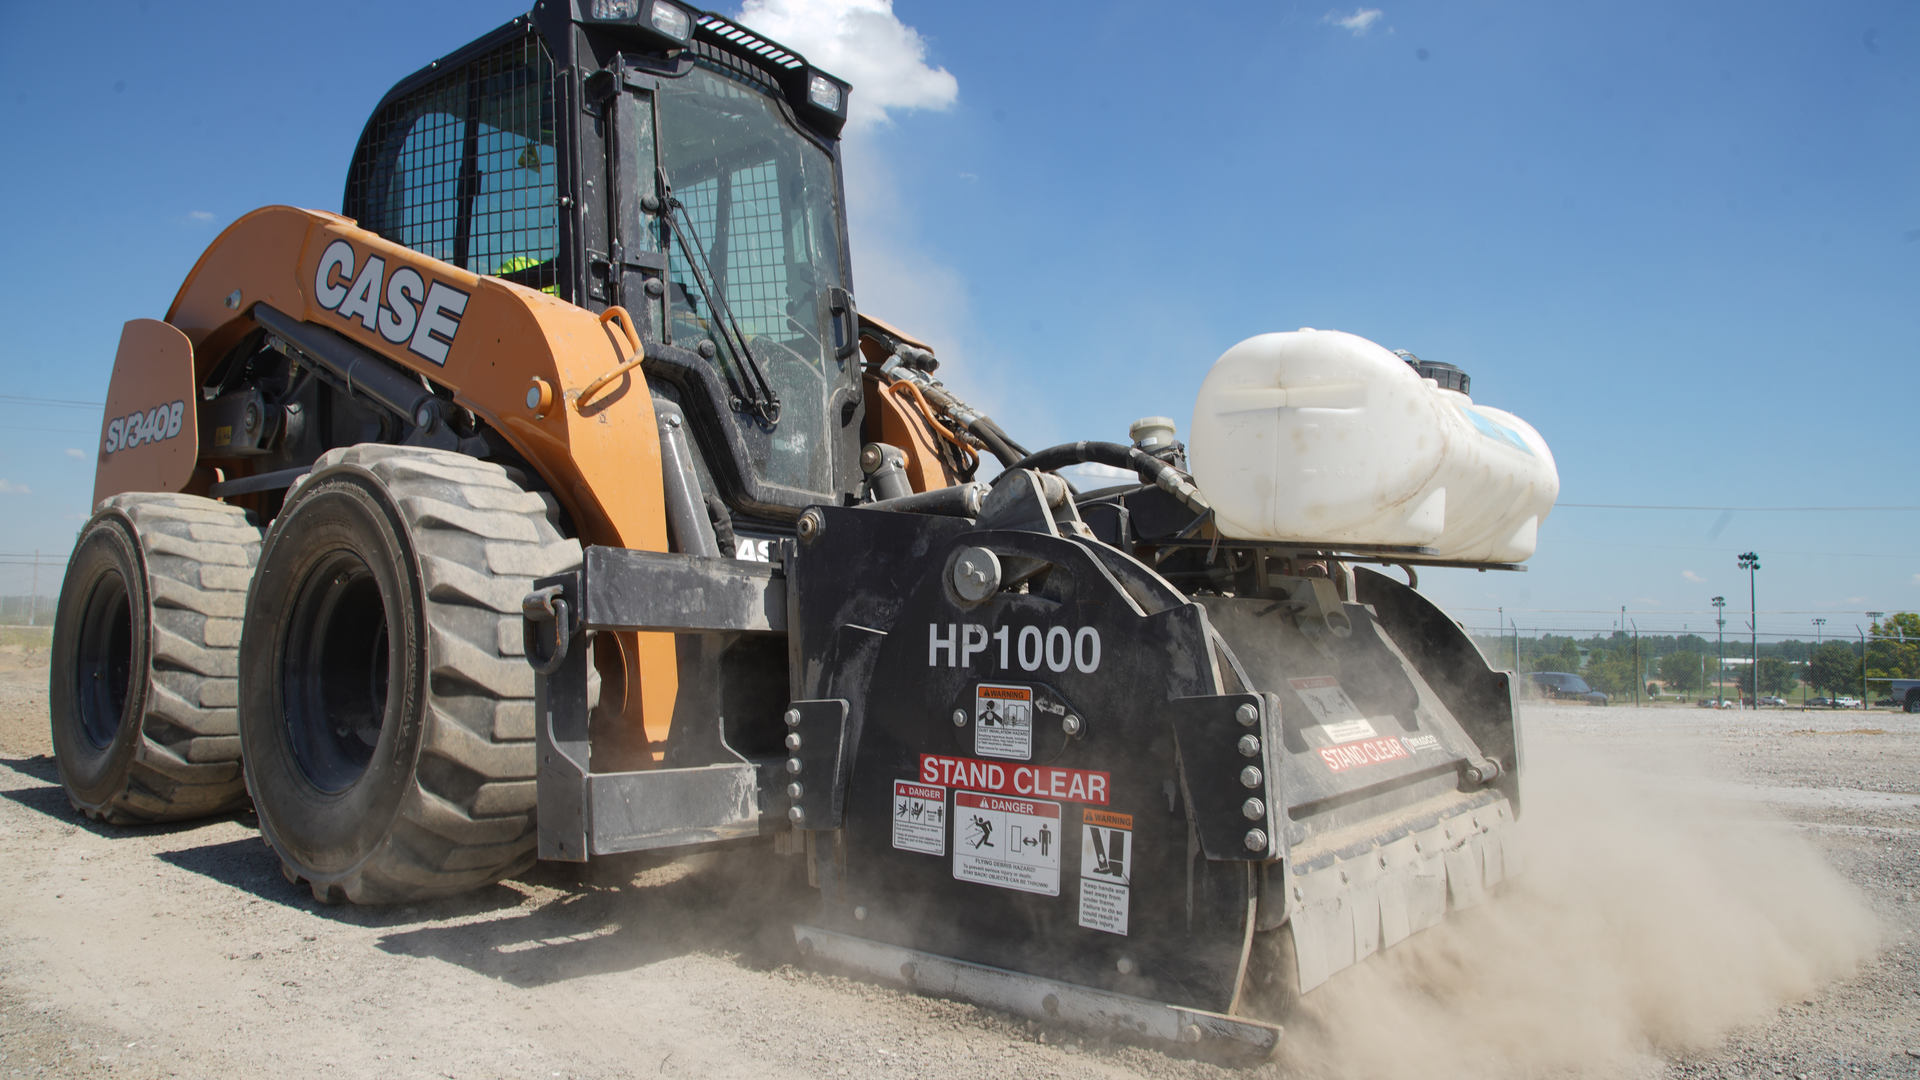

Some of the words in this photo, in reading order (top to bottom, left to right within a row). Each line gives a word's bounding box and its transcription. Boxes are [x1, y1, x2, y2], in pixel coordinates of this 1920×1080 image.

[315, 238, 471, 368] CASE
[105, 400, 185, 454] SV340B
[736, 539, 770, 562] AS
[928, 623, 1102, 674] HP1000
[990, 690, 1024, 699] WARNING
[1411, 735, 1437, 747] BRADCO
[1321, 742, 1368, 770] STAND
[1363, 738, 1407, 762] CLEAR
[923, 757, 1005, 790] STAND
[1014, 767, 1106, 802] CLEAR
[908, 787, 941, 799] DANGER
[991, 799, 1034, 814] DANGER
[1094, 813, 1131, 827] WARNING
[975, 858, 992, 867] FLYING
[993, 861, 1012, 870] DEBRIS
[988, 873, 1009, 882] OBJECTS
[1084, 881, 1097, 890] Keep
[1098, 883, 1114, 894] hands
[1115, 887, 1126, 895] and
[1095, 892, 1108, 900] away
[1109, 893, 1121, 901] from
[1083, 903, 1101, 912] Failure
[1108, 907, 1116, 915] do
[1083, 910, 1098, 918] could
[1098, 913, 1113, 921] result
[1083, 917, 1098, 926] bodily
